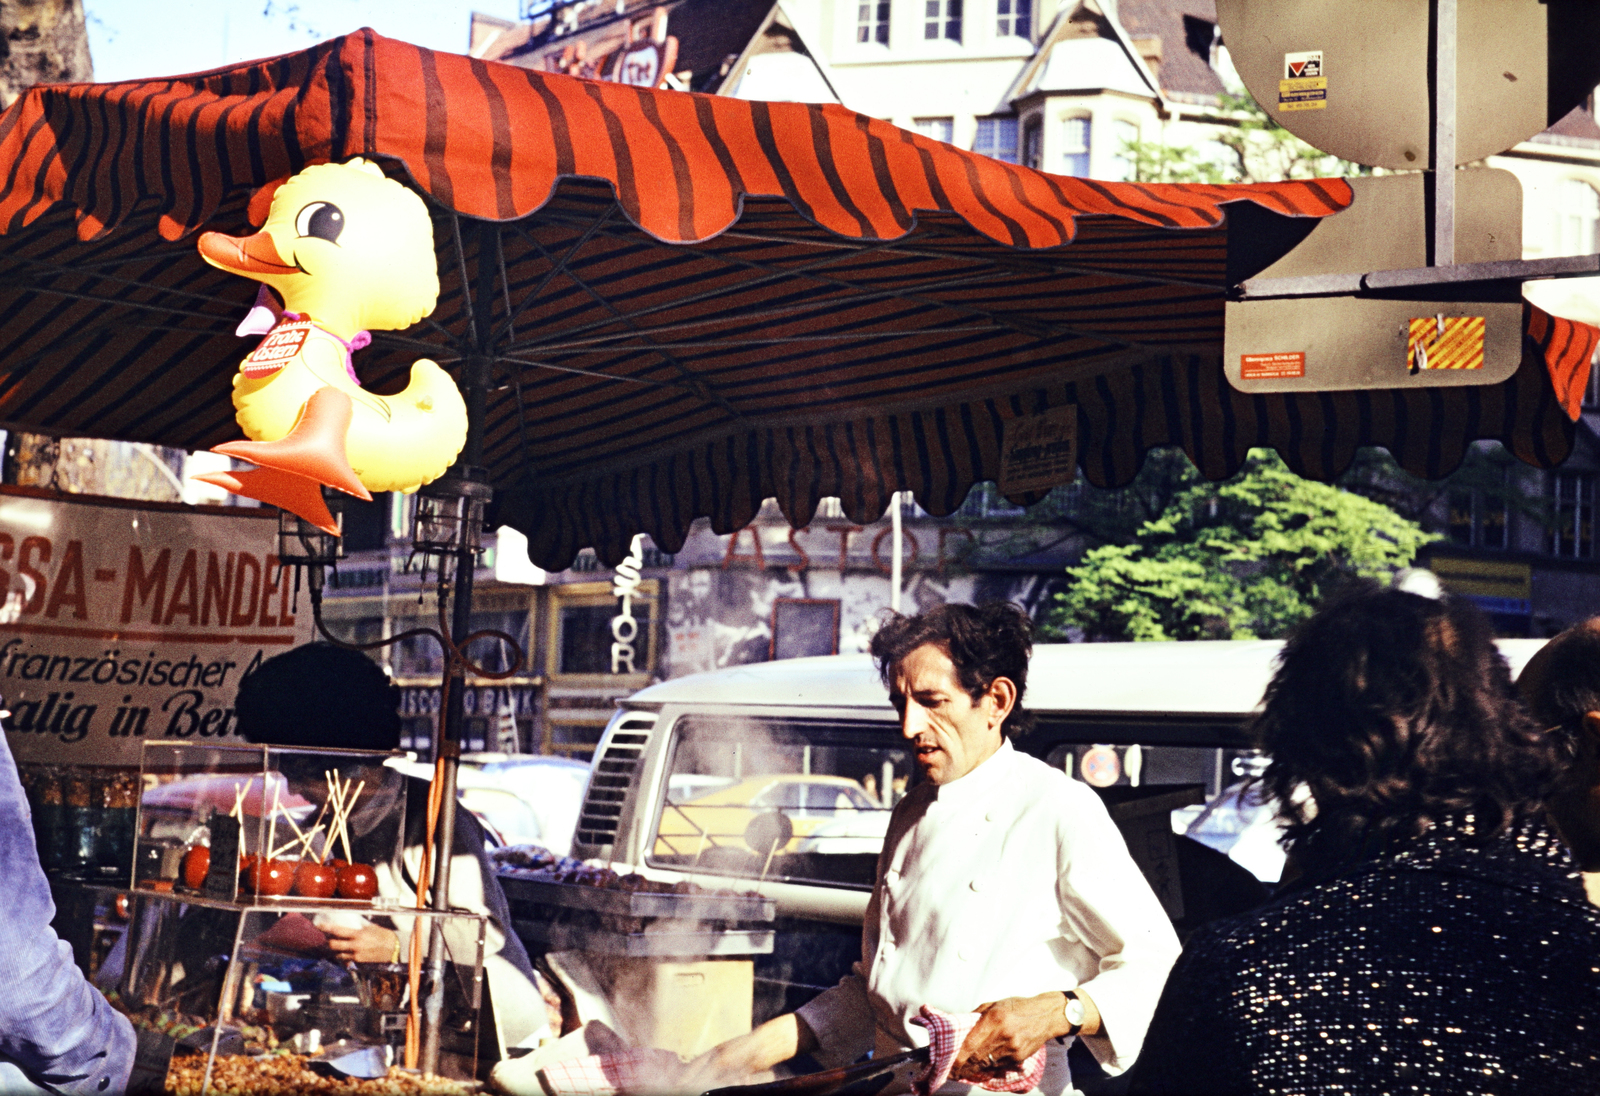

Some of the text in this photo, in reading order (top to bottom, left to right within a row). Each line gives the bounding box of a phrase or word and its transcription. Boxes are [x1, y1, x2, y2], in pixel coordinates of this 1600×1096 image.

[0, 638, 236, 687] französischer
[0, 692, 98, 743] alig
[108, 695, 150, 737] in
